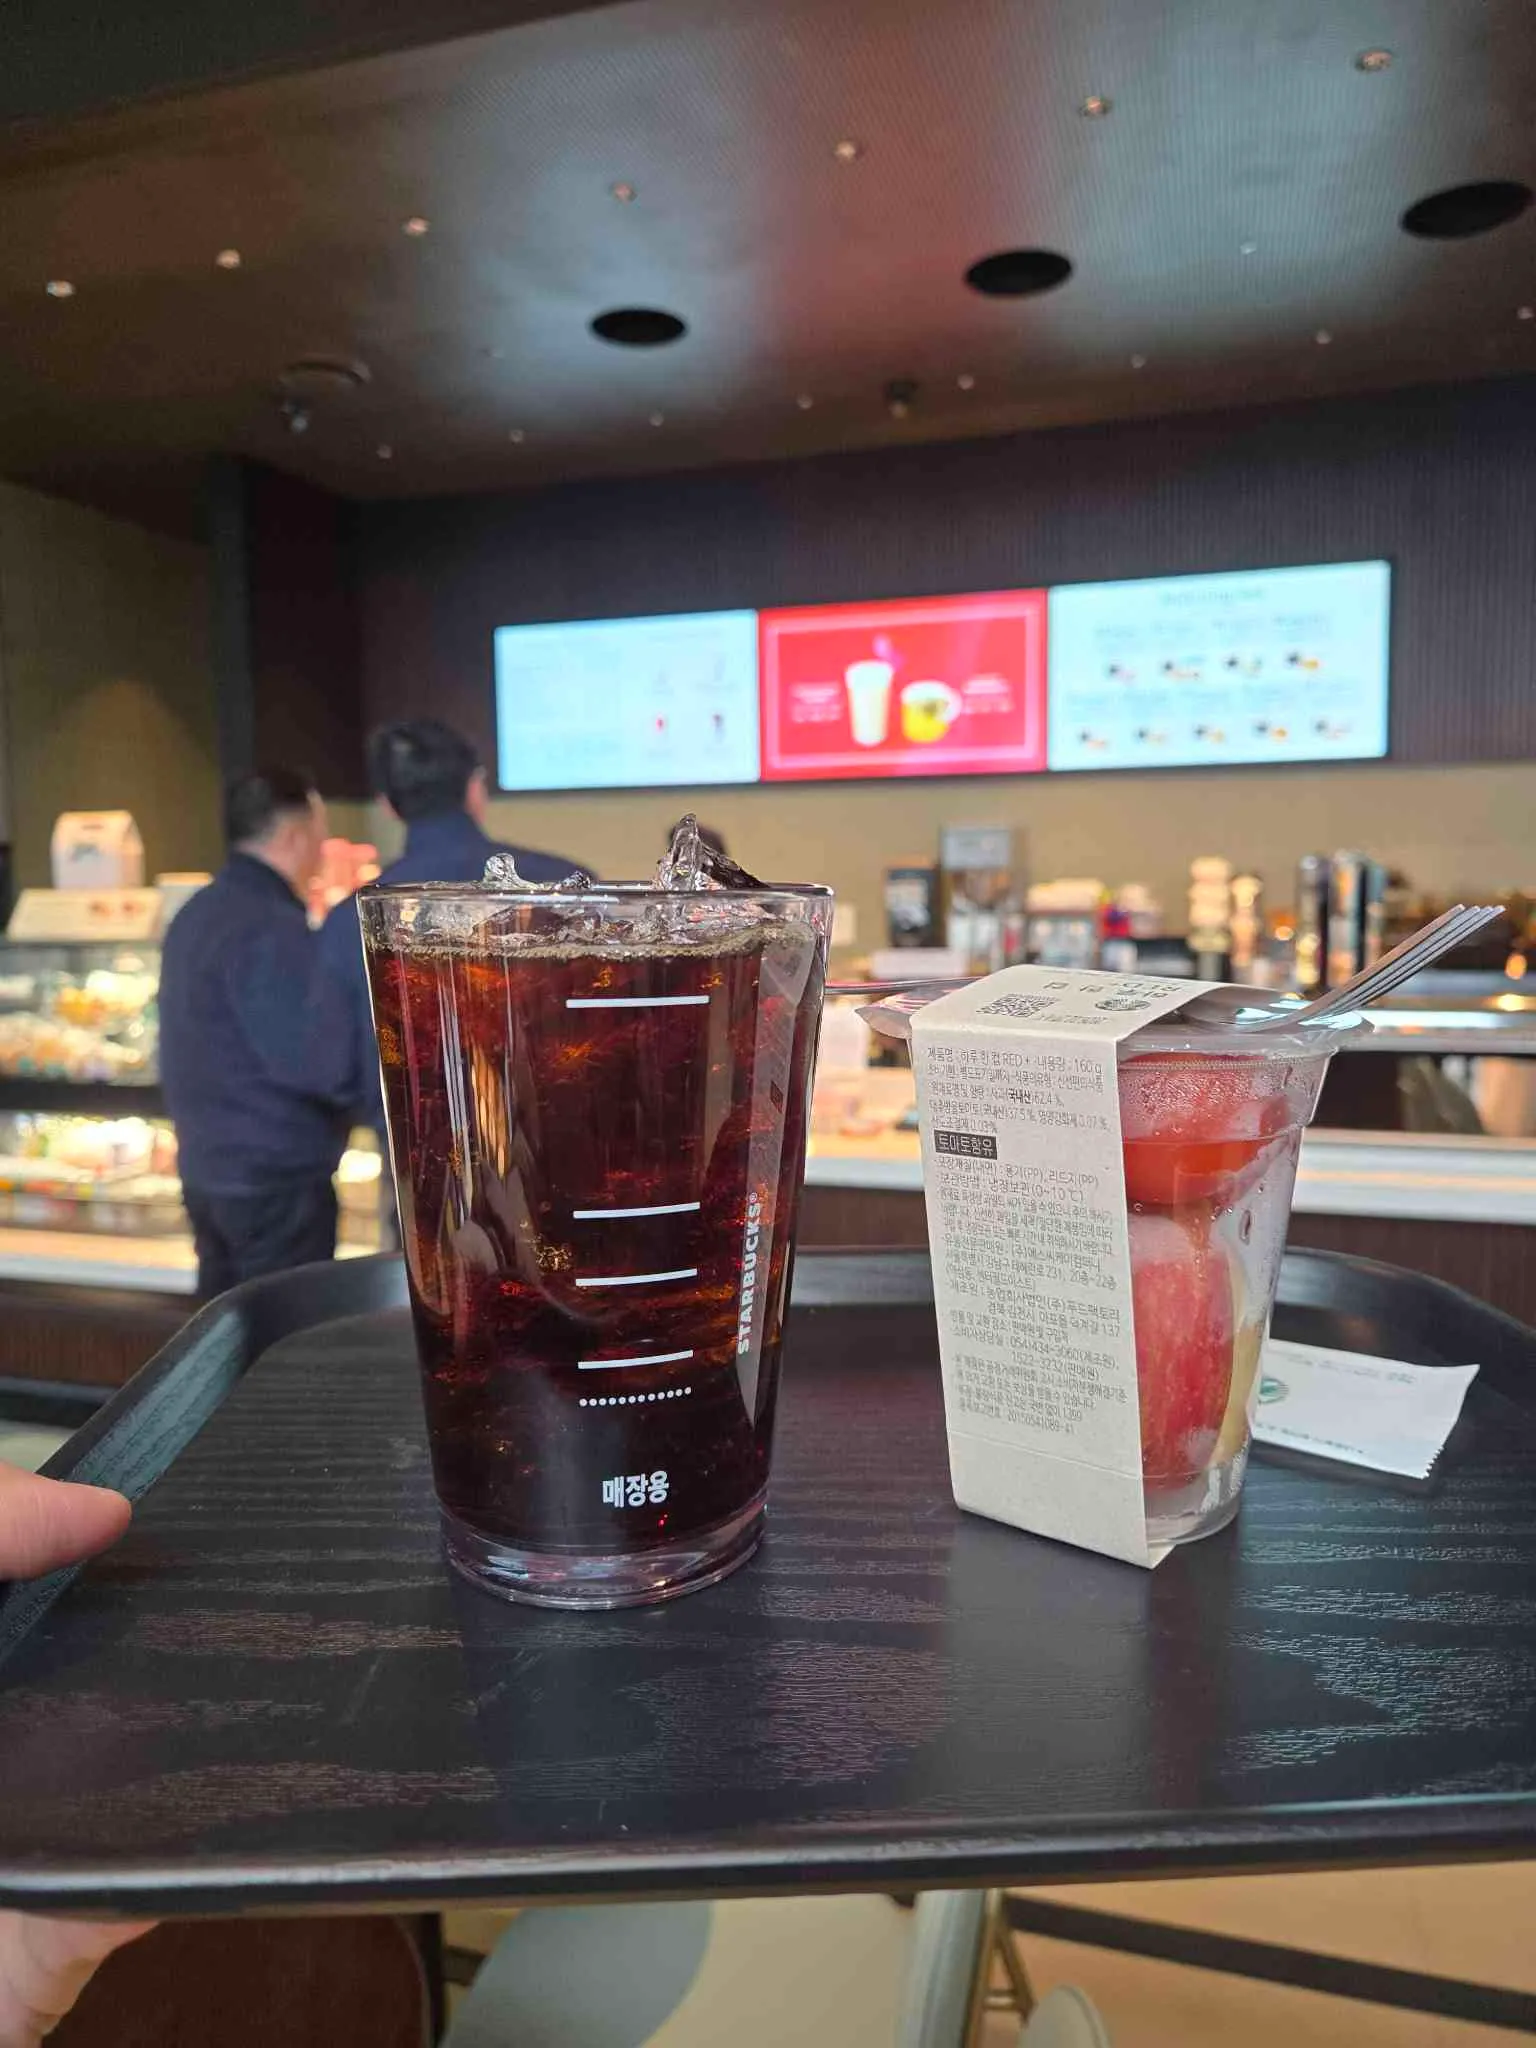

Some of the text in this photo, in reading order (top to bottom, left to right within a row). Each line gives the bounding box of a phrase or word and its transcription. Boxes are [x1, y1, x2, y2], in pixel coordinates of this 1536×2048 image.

[926, 1046, 953, 1061] 제품명
[959, 1049, 977, 1063] 하루
[991, 1051, 1000, 1065] 컵
[1001, 1052, 1022, 1067] RED
[1073, 1058, 1093, 1074] 160
[937, 1132, 994, 1156] 토마토함유
[602, 1470, 669, 1508] 매장용
